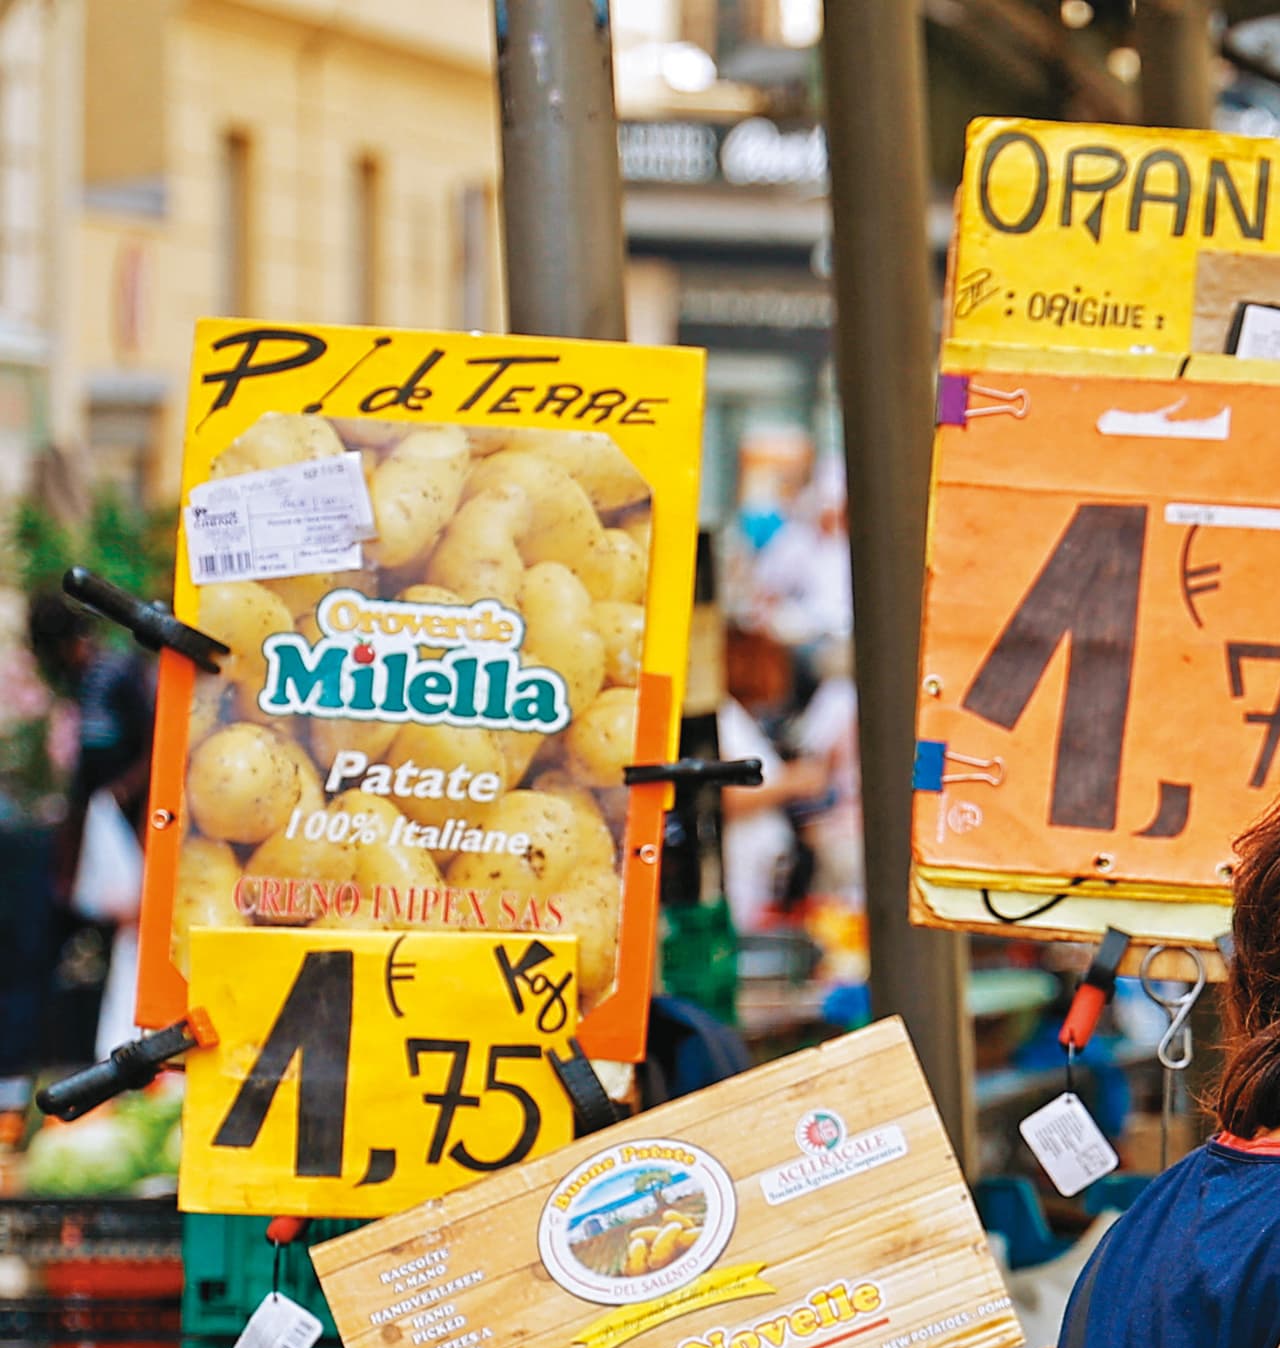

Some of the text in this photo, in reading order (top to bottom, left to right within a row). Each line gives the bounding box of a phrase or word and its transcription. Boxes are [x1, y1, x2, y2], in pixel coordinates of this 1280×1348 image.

[358, 350, 443, 412] de
[456, 356, 669, 426] TERRE
[329, 600, 515, 643] Oroverde
[270, 637, 560, 724] Milella
[326, 751, 499, 803] Patate
[285, 809, 531, 857] 100% Italiane
[233, 876, 567, 931] CRENO IMPEX SAS
[493, 940, 573, 1034] Kg
[552, 1157, 616, 1213] Buone
[620, 1145, 697, 1167] Patate
[380, 1248, 450, 1285] RACCOLTE
[406, 1264, 448, 1288] MANO
[614, 1258, 699, 1297] DEL SALENTO
[370, 1270, 485, 1325] HANDVERLESEN
[412, 1304, 456, 1329] HAND
[412, 1315, 468, 1346] PICKED
[911, 1310, 971, 1346] POTATOES
